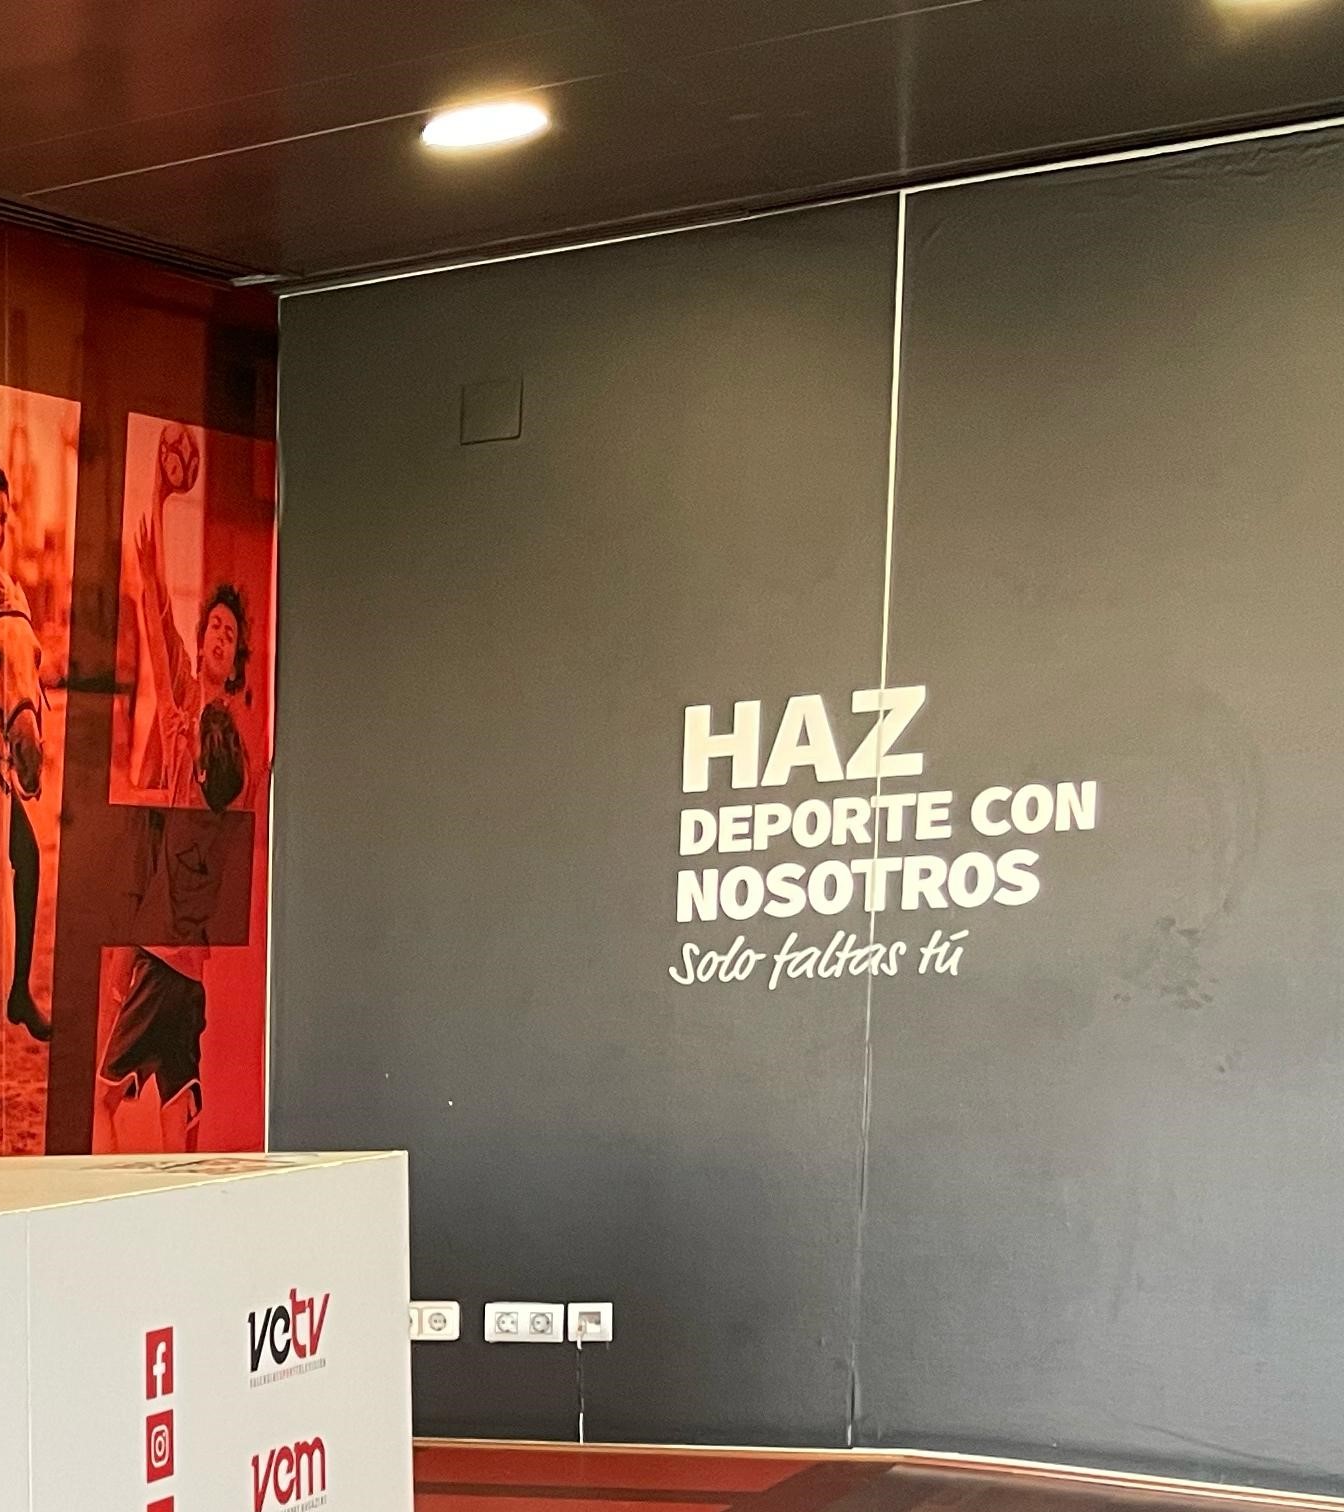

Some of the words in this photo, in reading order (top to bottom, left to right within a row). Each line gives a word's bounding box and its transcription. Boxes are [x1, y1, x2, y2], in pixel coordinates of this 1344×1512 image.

[682, 685, 927, 793] HAZ
[679, 790, 953, 856] DEPORTE
[970, 780, 1098, 837] CON
[676, 849, 1041, 922] NOSOTROS
[768, 930, 907, 990] faltas
[918, 929, 970, 976] tú
